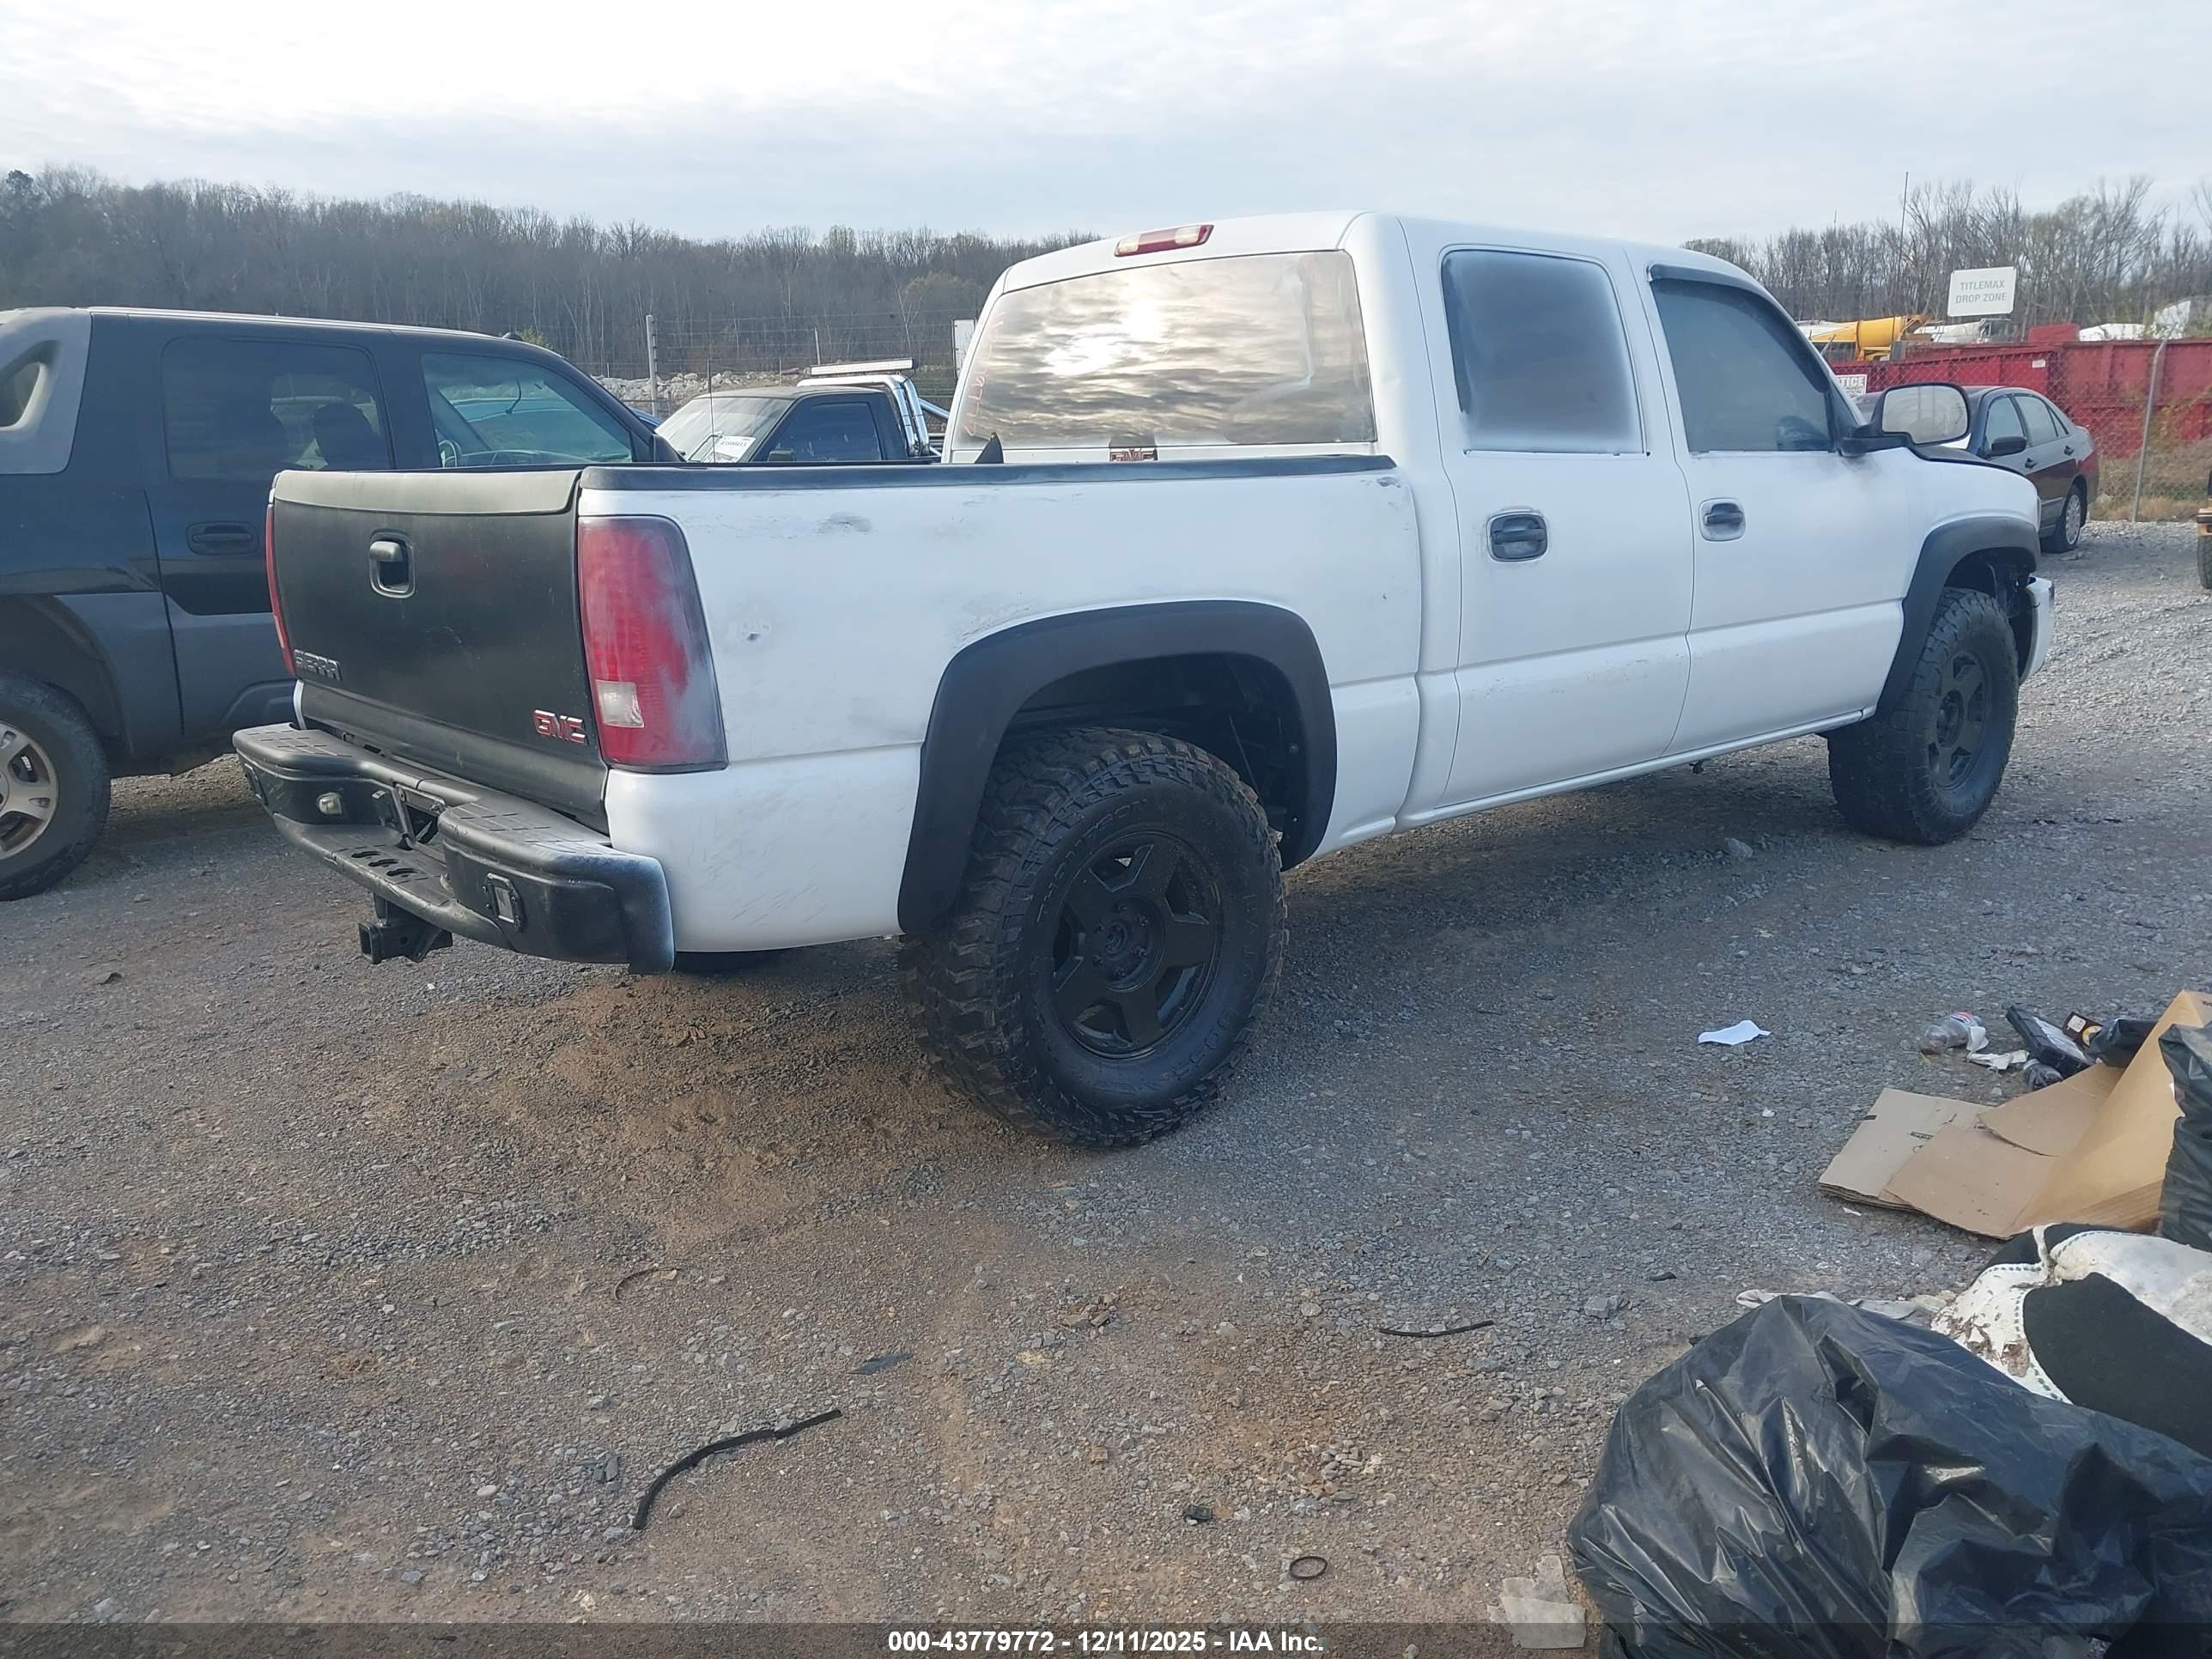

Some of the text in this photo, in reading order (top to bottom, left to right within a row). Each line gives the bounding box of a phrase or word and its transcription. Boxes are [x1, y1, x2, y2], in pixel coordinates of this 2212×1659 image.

[1960, 280, 2005, 290] TITLEMAX
[1955, 292, 2007, 304] DROP ZONE
[1835, 377, 1864, 386] TICE
[294, 648, 341, 680] SIERRA
[533, 708, 587, 744] GMC
